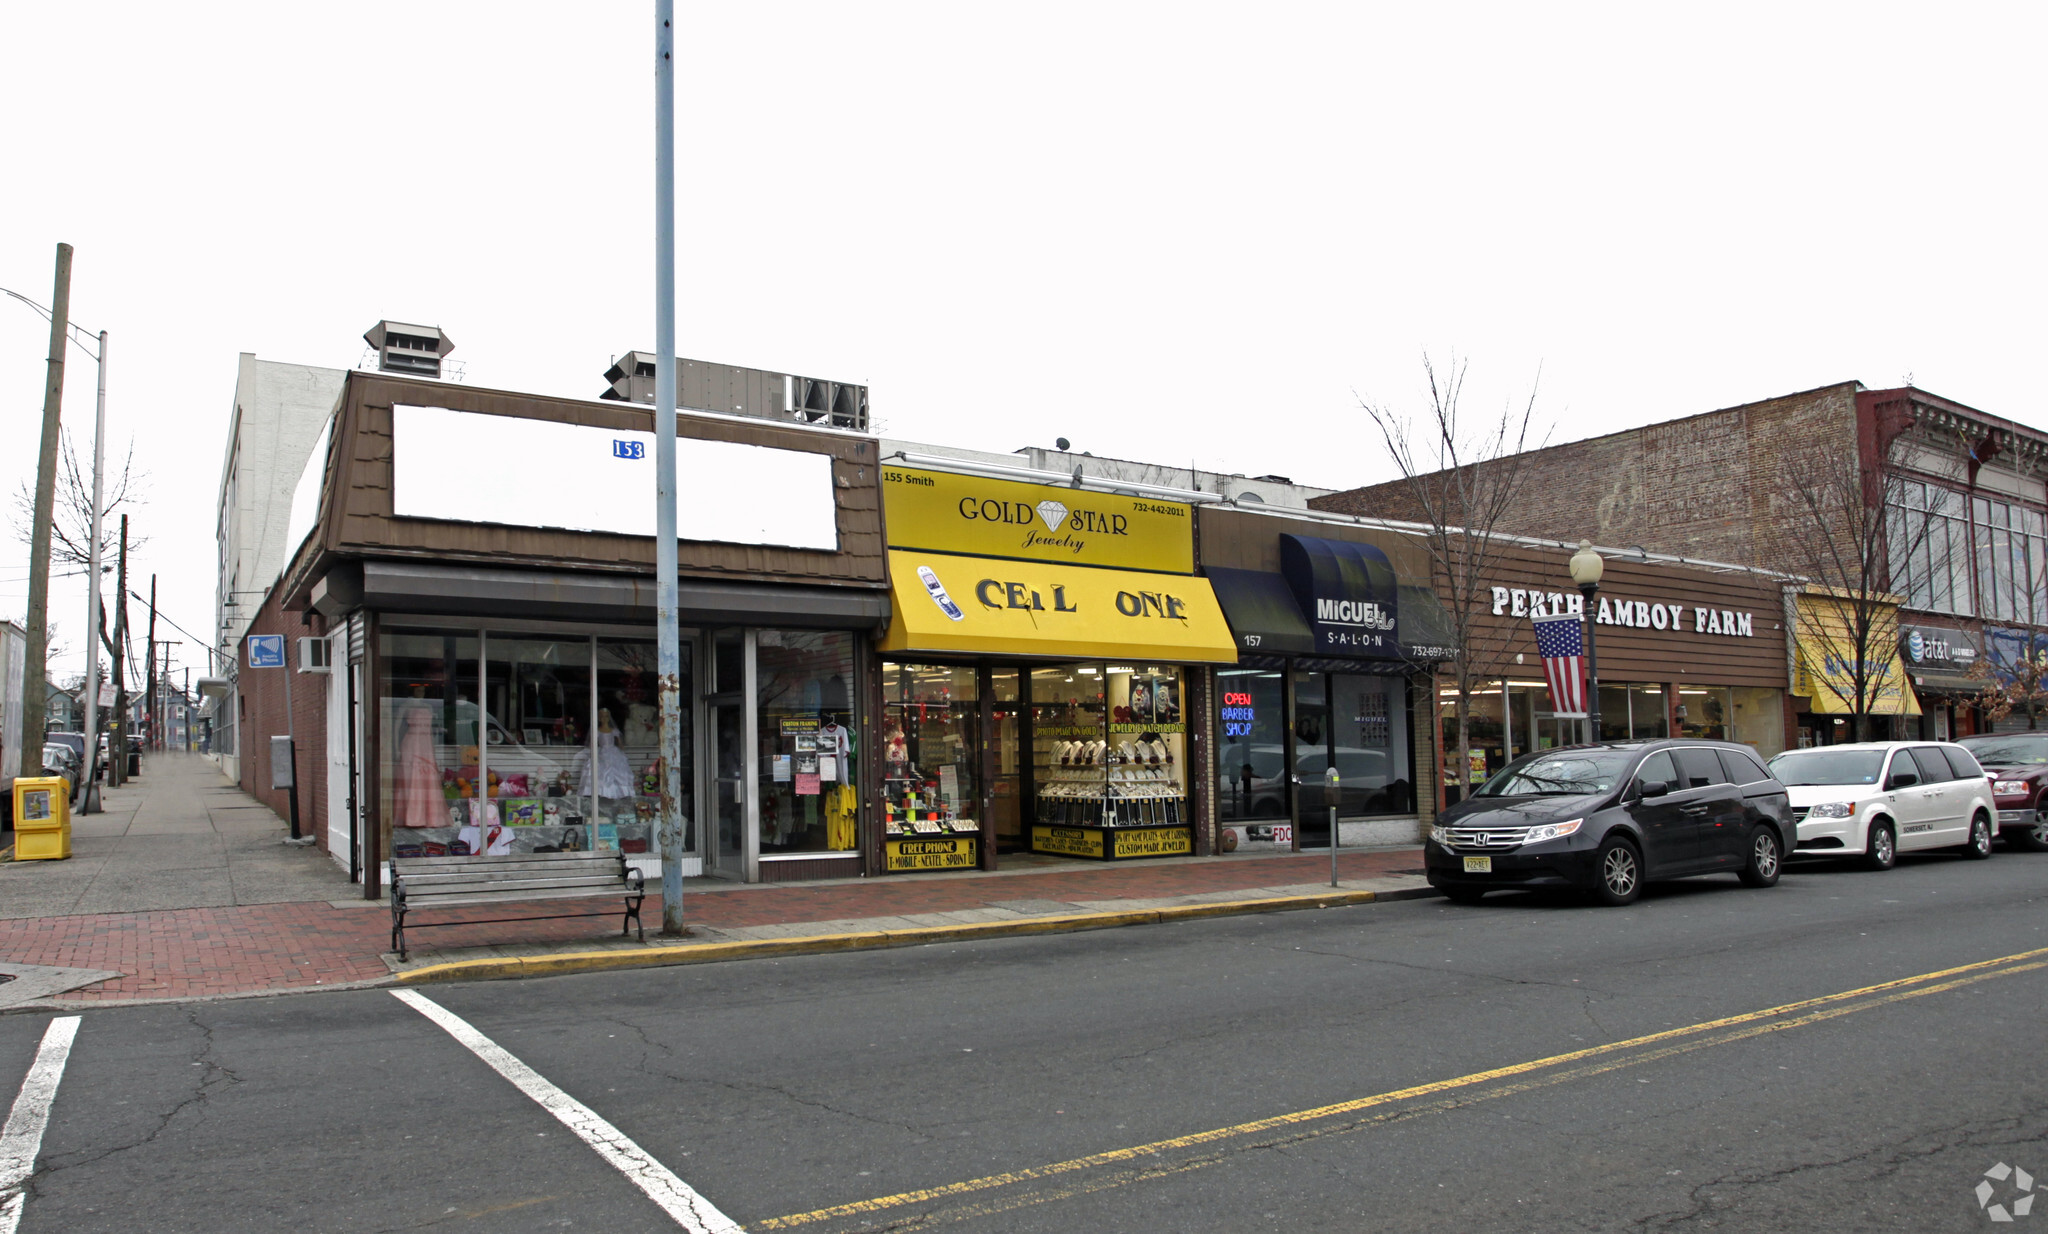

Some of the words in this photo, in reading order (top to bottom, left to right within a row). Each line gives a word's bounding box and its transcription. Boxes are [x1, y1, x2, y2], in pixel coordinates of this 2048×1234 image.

[615, 441, 643, 458] 153
[884, 472, 903, 483] 155
[905, 474, 935, 487] Smith
[959, 497, 1034, 525] GOLD
[1070, 509, 1128, 536] STAR
[1133, 502, 1185, 517] 732-442-2011
[1021, 529, 1085, 554] Jewelry
[1115, 590, 1188, 620] ONE
[1491, 586, 1585, 622] PERTH
[1596, 597, 1683, 631] AMBOY
[1694, 607, 1753, 637] FARM
[1244, 634, 1261, 647] 157
[1924, 637, 1950, 660] at&t
[1224, 692, 1252, 705] OPEN
[1222, 707, 1254, 720] BARBER
[1037, 726, 1055, 736] PHOTO
[1055, 726, 1072, 736] IMAGE
[1072, 726, 1081, 736] ON
[1081, 726, 1097, 736] GOLD
[1109, 723, 1136, 733] JEWELRY
[1136, 723, 1142, 734] &
[1142, 723, 1163, 733] WATCH
[1164, 723, 1185, 733] REPAIR
[1225, 722, 1252, 736] SHOP
[1273, 827, 1292, 842] FDC
[902, 842, 924, 854] FREE
[925, 841, 954, 853] PHONE
[1118, 843, 1143, 855] CUSTOM
[1143, 842, 1160, 853] MADE
[1161, 840, 1186, 852] JEWELRY
[889, 855, 917, 869] T-MOBILE
[921, 854, 942, 867] NEXTEL
[946, 853, 967, 866] SPRINT
